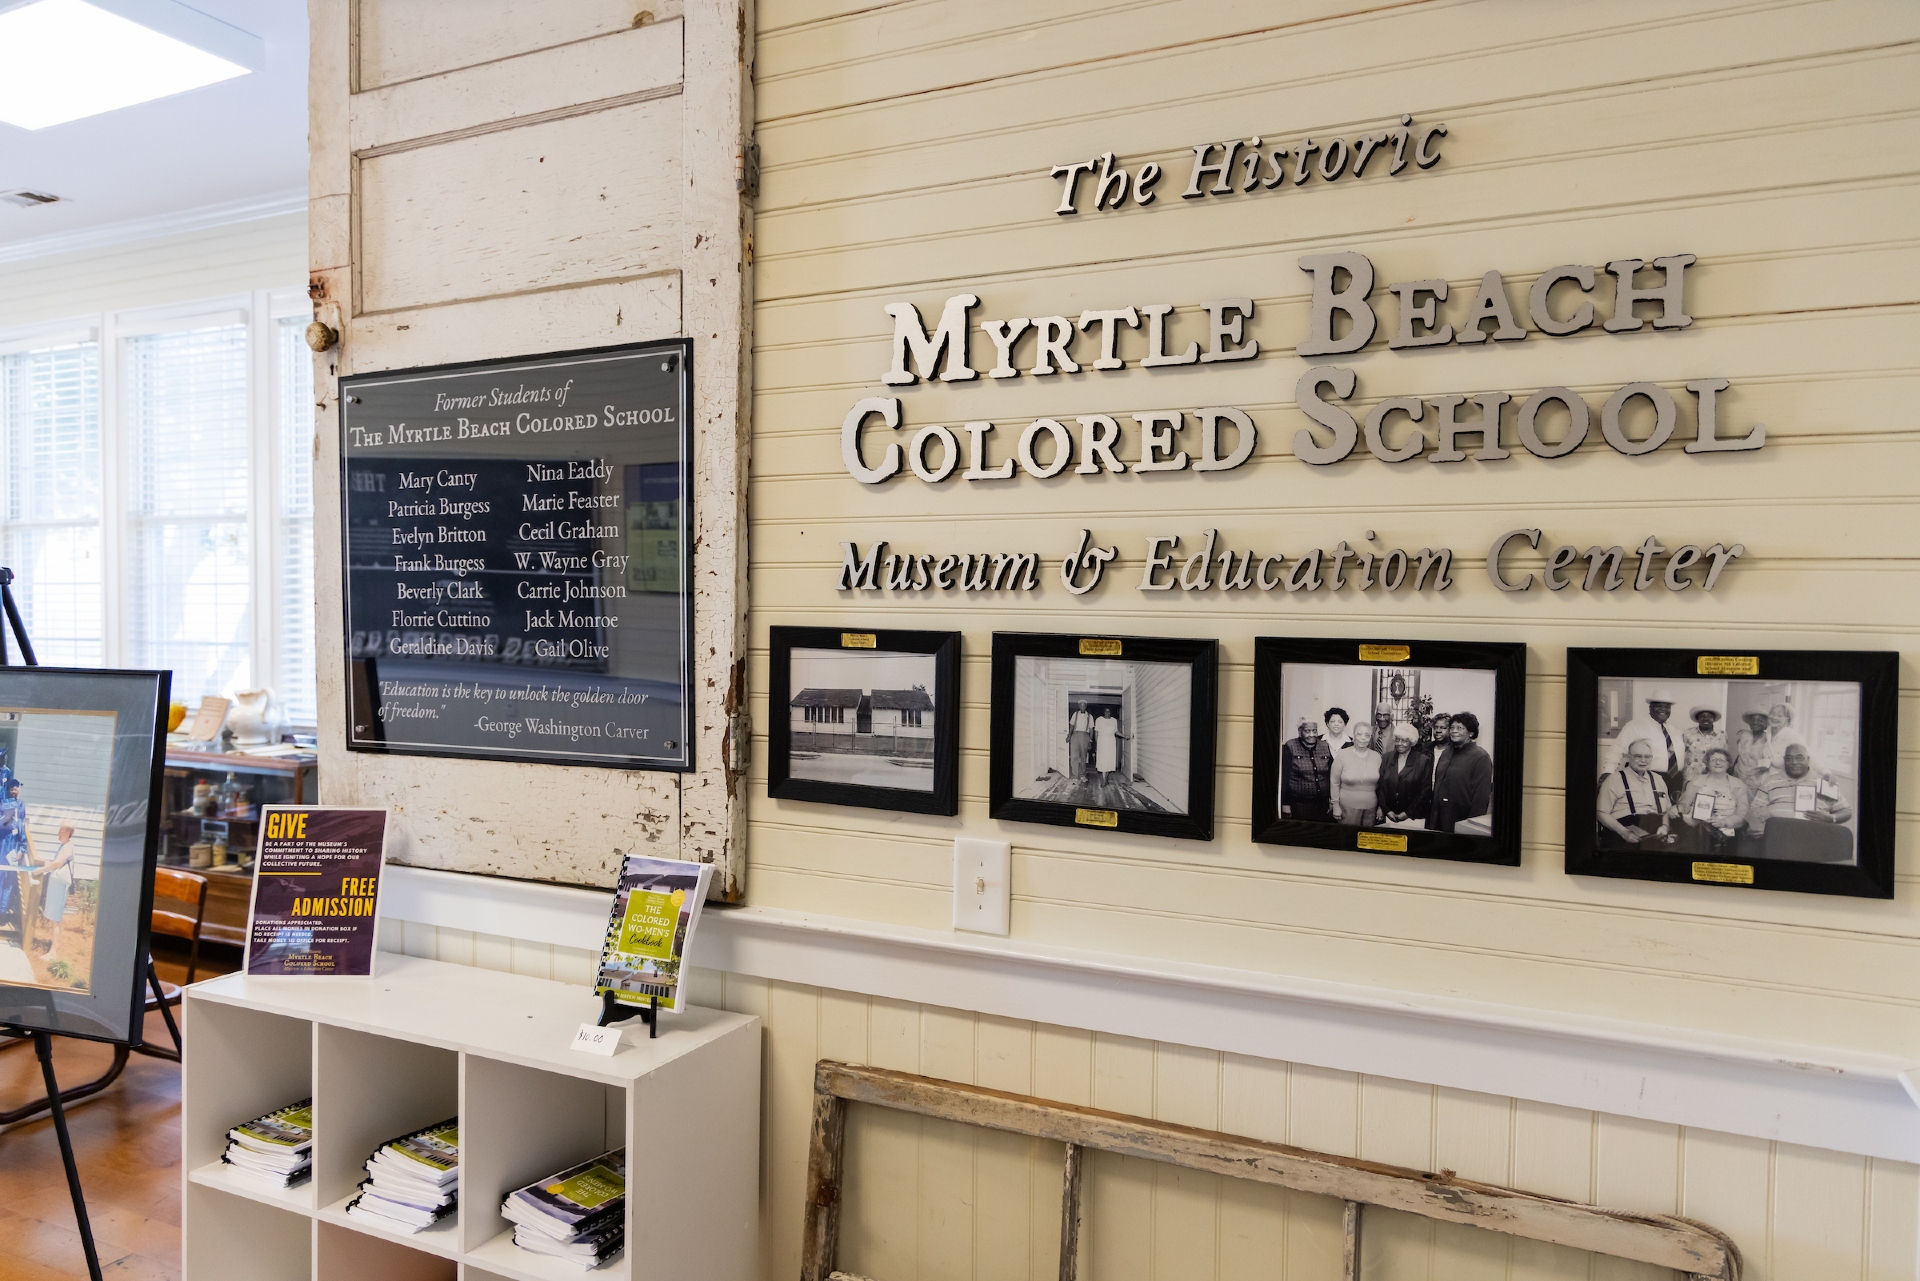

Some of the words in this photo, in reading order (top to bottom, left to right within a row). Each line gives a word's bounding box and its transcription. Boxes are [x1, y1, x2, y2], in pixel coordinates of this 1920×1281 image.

[1050, 150, 1162, 216] The
[1181, 113, 1448, 200] Historic
[880, 293, 1260, 387] MYRTLE
[1295, 250, 1697, 357] BEACH
[434, 391, 487, 413] Former
[489, 383, 552, 406] Students
[555, 378, 574, 407] of
[350, 425, 384, 447] THE
[387, 422, 453, 446] MYRTLE
[457, 416, 511, 440] BEACH
[516, 411, 598, 434] COLORED
[603, 404, 675, 428] SCHOOL
[840, 395, 1258, 485] COLORED
[1293, 365, 1766, 466] SCHOOL
[399, 471, 434, 494] Mary
[437, 469, 478, 492] Canty
[527, 463, 565, 483] Nina
[567, 458, 614, 485] Eaddy
[388, 497, 436, 518] Patricia
[439, 497, 490, 521] Burgess
[522, 493, 564, 512] Marie
[568, 490, 620, 510] Feaster
[392, 526, 434, 550] Evelyn
[437, 525, 486, 544] Britton
[518, 521, 555, 541] Cecil
[557, 520, 619, 540] Graham
[394, 554, 431, 572] Frank
[434, 554, 485, 578] Burgess
[514, 552, 535, 570] W.
[539, 551, 588, 576] Wayne
[591, 549, 630, 574] Gray
[833, 540, 1040, 593] Museum
[1059, 528, 1119, 596] &
[1134, 528, 1453, 593] Education
[1485, 527, 1745, 593] Center
[397, 581, 444, 605] Beverly
[446, 580, 484, 600] Clark
[517, 580, 561, 599] Carrie
[563, 580, 627, 604] Johnson
[392, 609, 434, 627] Florrie
[437, 609, 490, 628] Cuttino
[524, 609, 555, 632] Jack
[558, 609, 619, 629] Monroe
[390, 637, 454, 656] Geraldine
[456, 637, 494, 656] Davis
[535, 638, 566, 658] Gail
[569, 638, 609, 659] Olive
[379, 681, 438, 698] "Education
[442, 684, 451, 698] is
[453, 683, 472, 699] the
[473, 683, 494, 704] key
[495, 686, 507, 700] to
[509, 685, 548, 702] unlock
[551, 685, 571, 702] the
[573, 686, 615, 708] golden
[618, 687, 649, 705] door
[378, 702, 393, 722] of
[389, 702, 446, 722] freedom."
[474, 716, 522, 738] -George
[525, 717, 601, 741] Washington
[605, 722, 649, 740] Carver
[267, 813, 308, 839] GIVE
[341, 877, 376, 896] FREE
[291, 897, 374, 917] ADMISSION
[645, 904, 662, 915] THE
[628, 923, 670, 938] WO-MEN'S
[631, 913, 670, 927] COLORED
[629, 933, 663, 947] Cookbook
[576, 1180, 609, 1197] COLORED
